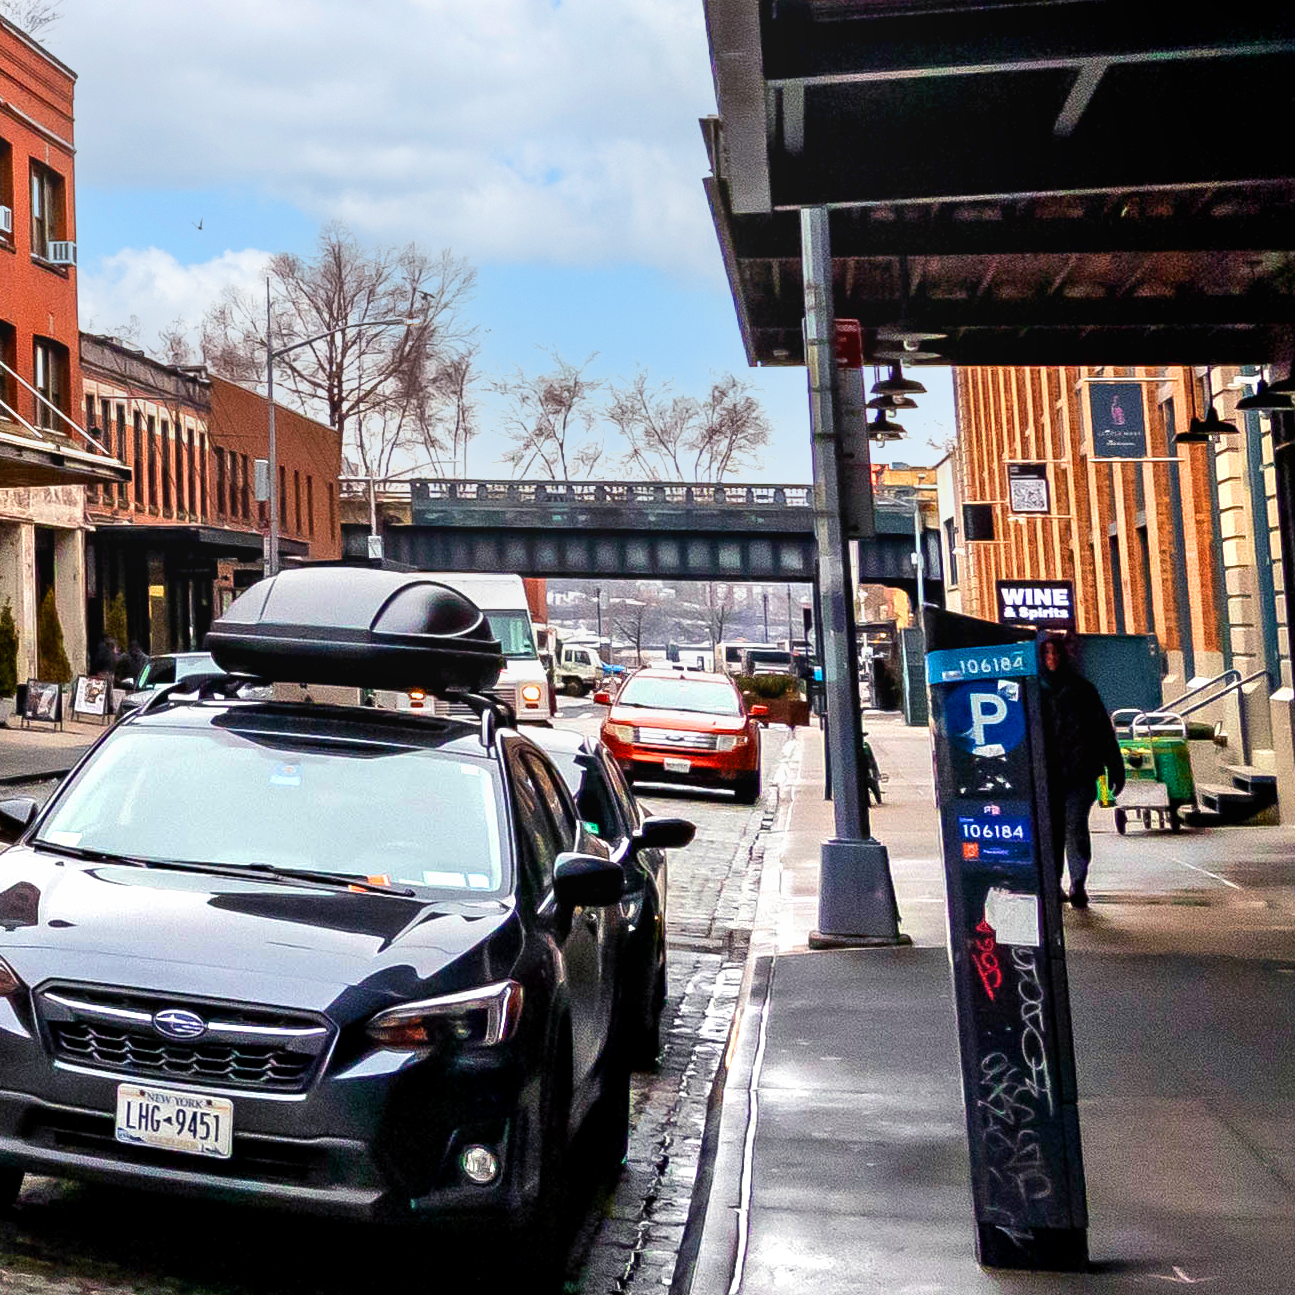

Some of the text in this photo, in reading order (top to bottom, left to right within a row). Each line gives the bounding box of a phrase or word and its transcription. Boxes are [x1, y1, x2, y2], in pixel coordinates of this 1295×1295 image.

[1001, 588, 1070, 606] WINE
[1004, 606, 1069, 621] & Spirits
[960, 655, 1024, 674] 106184
[970, 693, 1008, 746] P
[962, 823, 1024, 839] 106184
[146, 1092, 204, 1110] NEW YORK
